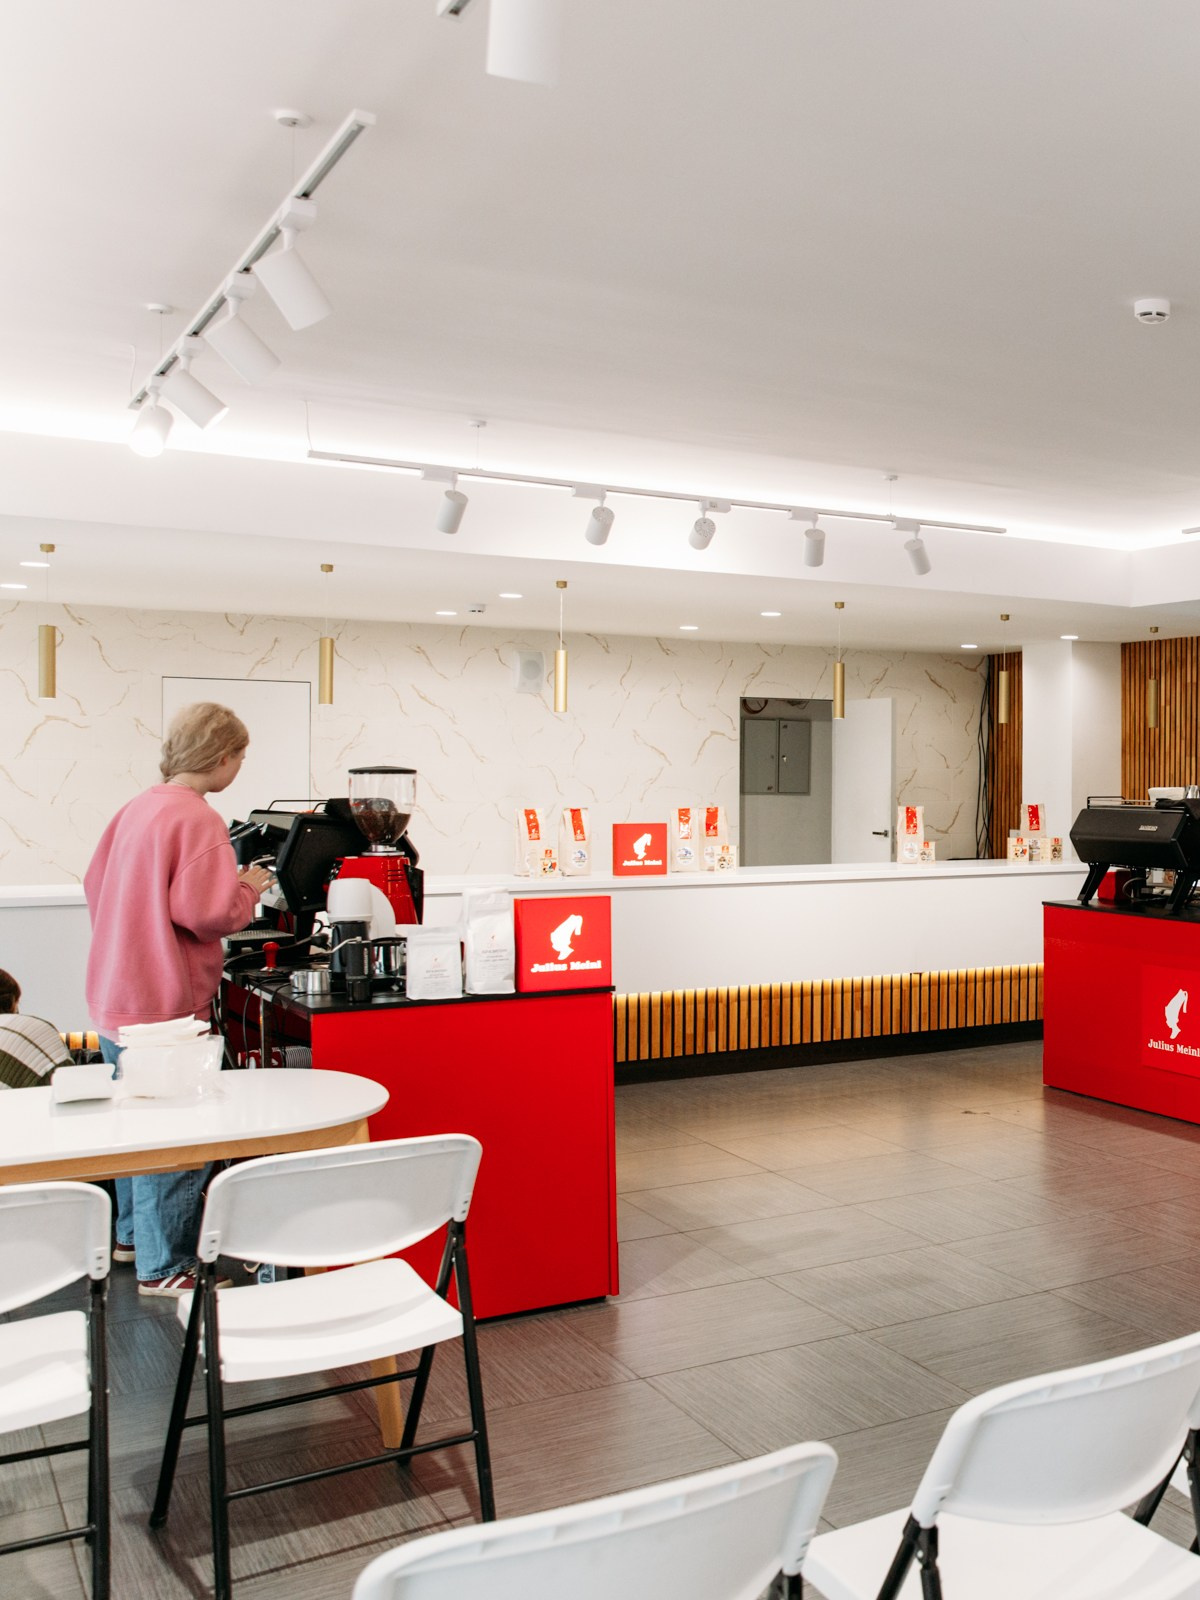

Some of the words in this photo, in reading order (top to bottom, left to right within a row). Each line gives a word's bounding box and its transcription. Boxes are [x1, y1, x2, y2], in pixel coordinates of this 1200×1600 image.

[530, 961, 567, 973] Julius
[1148, 1038, 1174, 1052] Julius
[1177, 1044, 1200, 1058] Meinl
